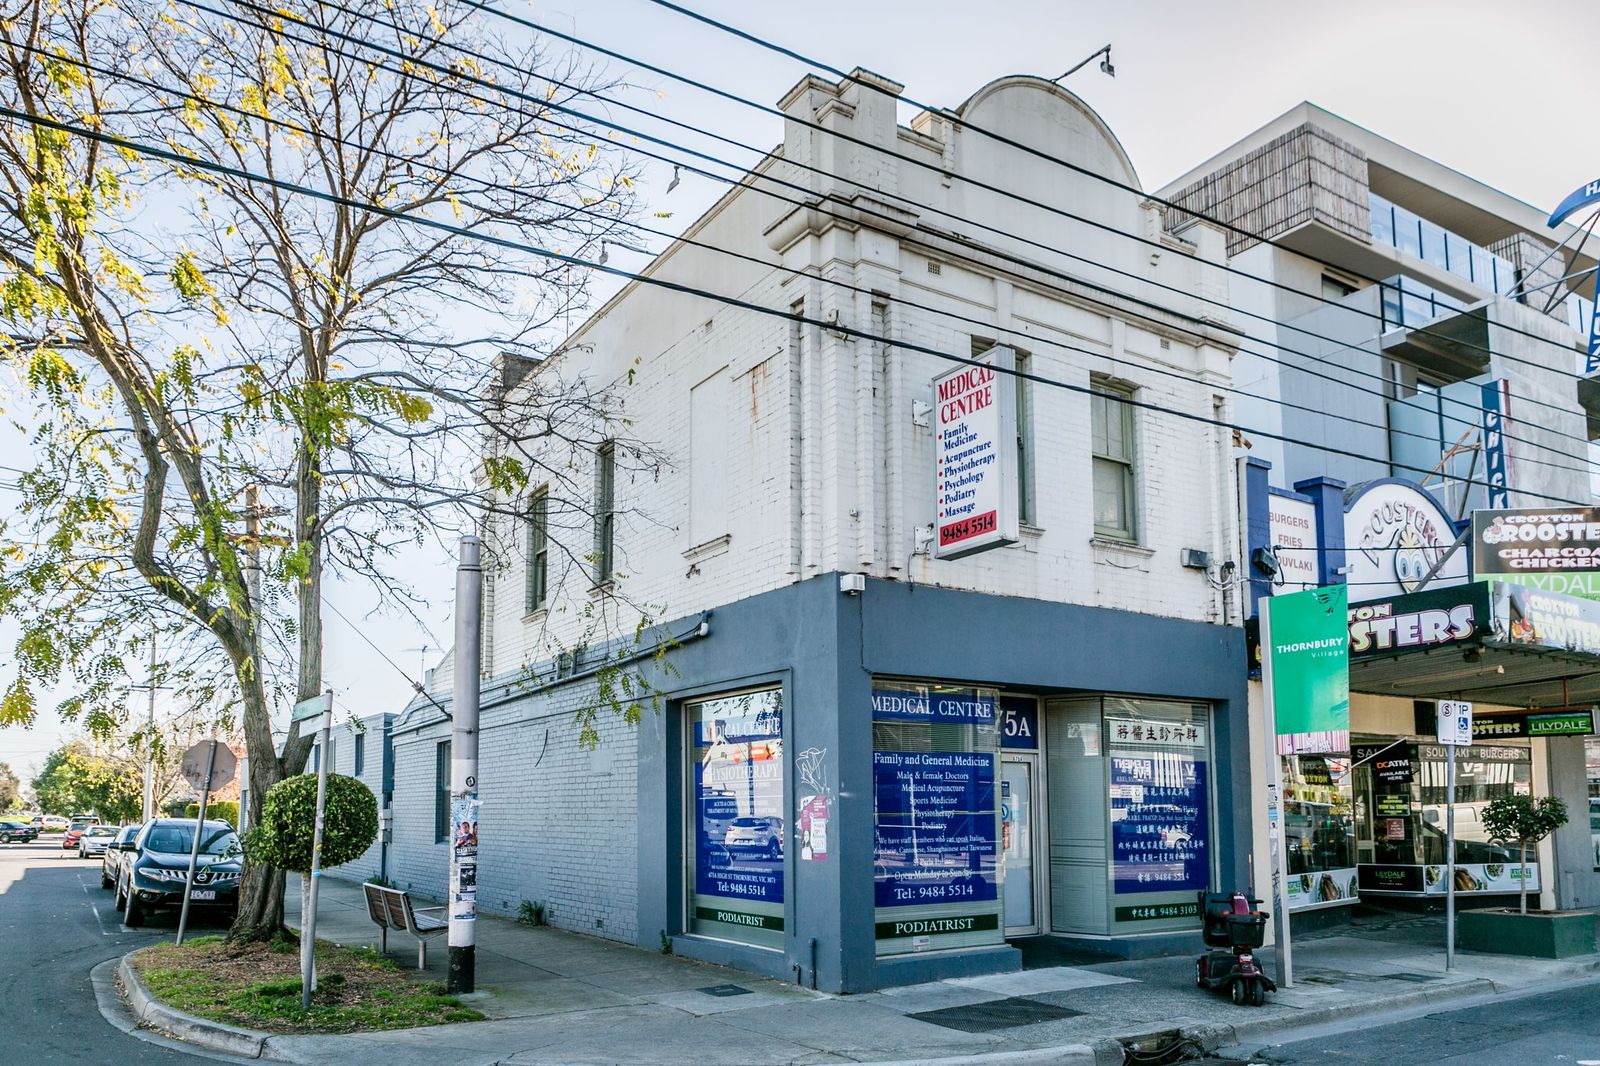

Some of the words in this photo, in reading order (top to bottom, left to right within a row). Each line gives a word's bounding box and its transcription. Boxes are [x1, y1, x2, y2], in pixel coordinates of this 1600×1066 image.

[938, 360, 995, 403] MEDICAL
[941, 385, 992, 424] CENTRE
[944, 423, 968, 440] Family
[944, 432, 978, 451] Medicine
[944, 440, 992, 464] Acupuncture
[944, 452, 996, 478] Physiotherapy
[945, 471, 985, 491] Psychology
[945, 489, 976, 505] Podiatry
[945, 502, 976, 518] Massage
[1269, 511, 1309, 529] BURGERS
[1505, 514, 1584, 523] CROXTON
[943, 521, 968, 543] 9484
[970, 514, 994, 535] 5514
[1278, 534, 1303, 548] FRIES
[1277, 556, 1313, 571] OUVLAKI
[1276, 637, 1344, 654] THORNBURY
[1311, 649, 1345, 658] Village
[872, 696, 934, 715] MEDICAL
[938, 699, 991, 718] CENTRE
[1000, 710, 1031, 737] 5A
[1531, 721, 1587, 731] LILYDALE
[874, 753, 902, 767] Family
[904, 755, 920, 764] and
[922, 755, 952, 766] General
[954, 756, 989, 767] Medicine
[1426, 747, 1469, 758] SOUAKI
[1480, 748, 1519, 759] BURGERS
[897, 771, 912, 779] Male
[923, 772, 943, 780] female
[902, 784, 926, 792] Medical
[927, 784, 964, 793] Acupuncture
[910, 797, 928, 806] Sports
[913, 808, 955, 819] Physiotherapy
[922, 822, 947, 831] Podiatry
[901, 836, 911, 844] staff
[969, 844, 992, 852] Taiwanese
[894, 871, 913, 881] Open
[717, 881, 729, 892] Tel:
[730, 883, 747, 894] 9484
[748, 885, 766, 896] 5514
[894, 888, 916, 899] Tel:
[919, 886, 945, 898] 9484
[948, 885, 973, 896] 5514
[1160, 907, 1178, 916] 9484
[1180, 905, 1197, 914] 3103
[717, 911, 764, 927] PODIATRIST
[895, 918, 974, 934] PODIATRIST
